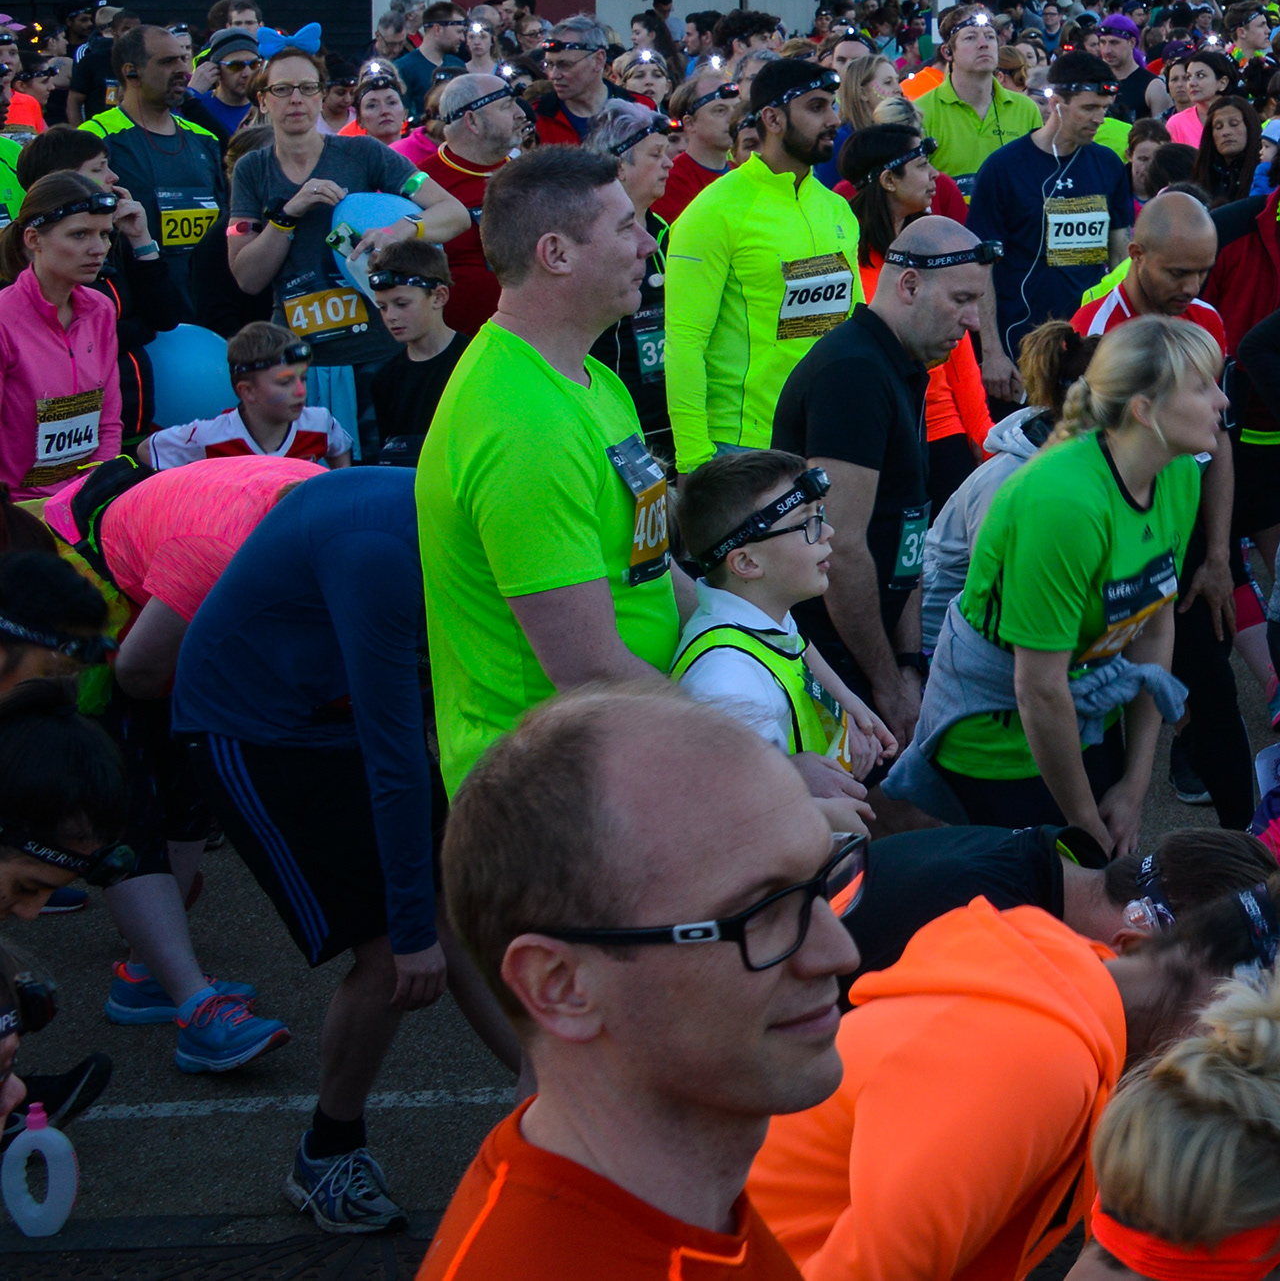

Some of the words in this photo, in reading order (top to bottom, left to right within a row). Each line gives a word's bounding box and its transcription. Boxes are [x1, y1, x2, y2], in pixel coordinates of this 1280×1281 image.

[165, 215, 216, 241] 2057
[1054, 221, 1105, 238] 70067
[928, 251, 979, 267] SUPERNOVA
[787, 283, 847, 307] 70602
[290, 294, 359, 331] 4107
[43, 425, 94, 455] 70144
[776, 490, 805, 515] SUPER
